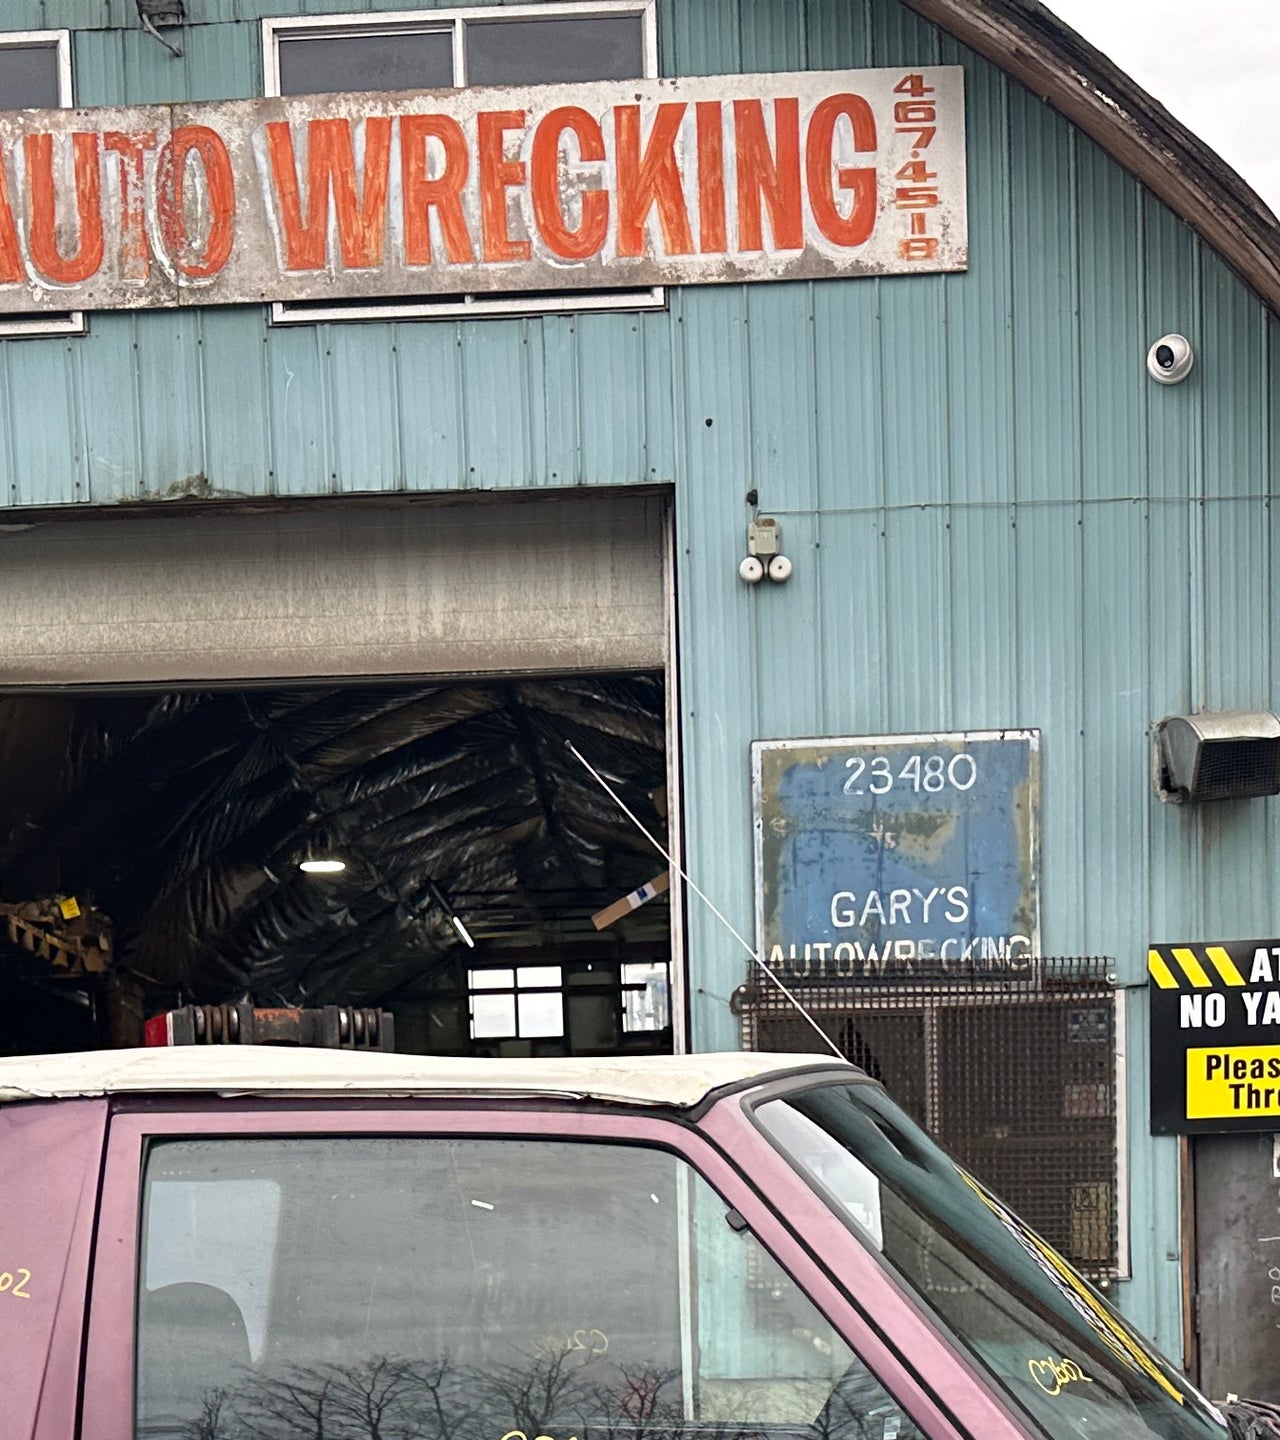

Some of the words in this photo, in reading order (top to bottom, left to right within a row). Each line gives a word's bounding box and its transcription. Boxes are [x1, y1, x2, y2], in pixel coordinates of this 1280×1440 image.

[262, 92, 879, 273] WRECKING
[843, 753, 977, 796] 23480
[831, 886, 970, 928] GARY'S
[1179, 993, 1226, 1029] NO
